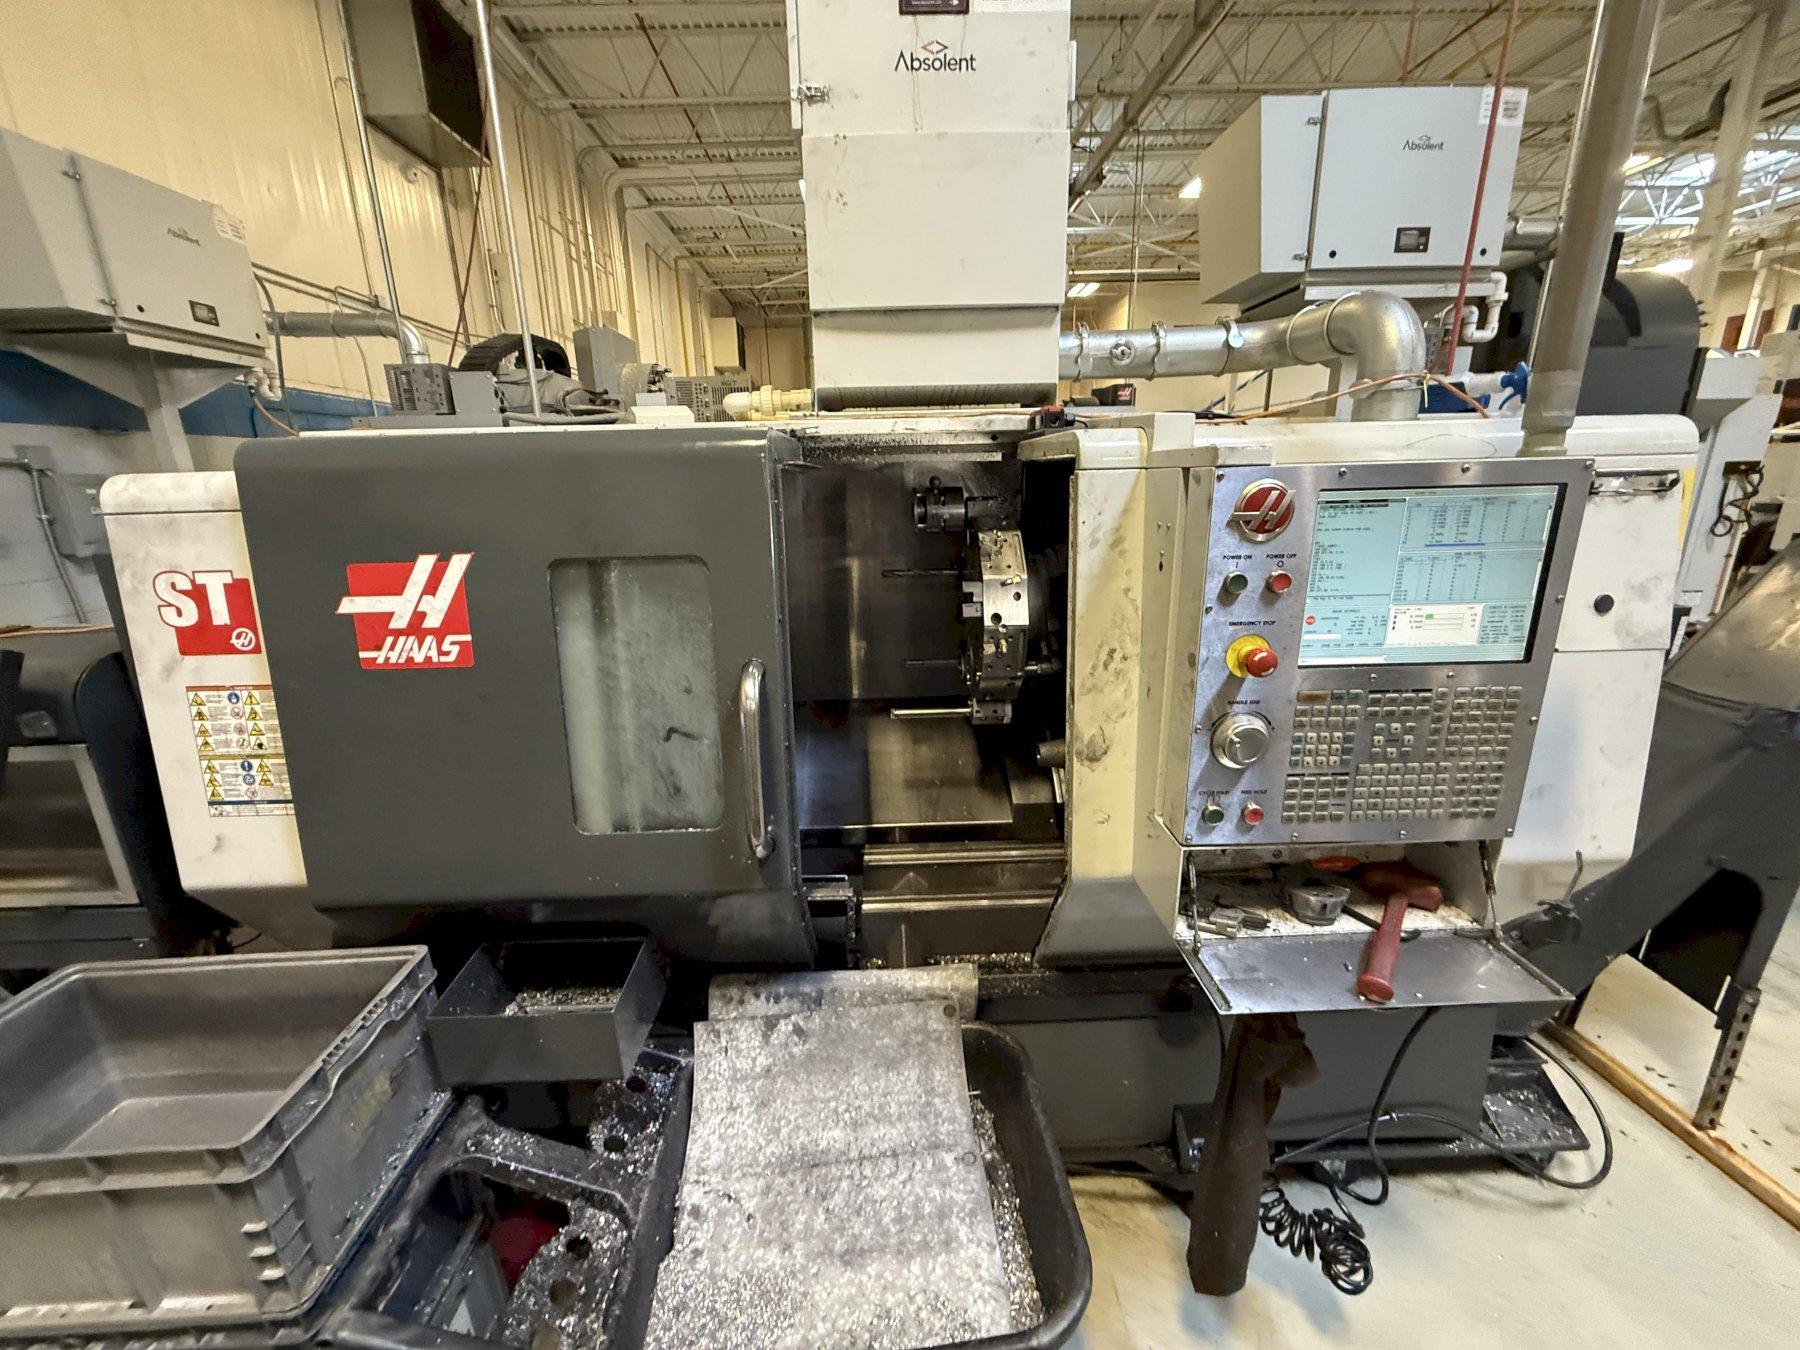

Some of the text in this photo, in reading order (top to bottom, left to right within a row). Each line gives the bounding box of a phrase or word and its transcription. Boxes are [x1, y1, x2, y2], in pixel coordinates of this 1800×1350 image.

[894, 49, 976, 72] Absolent
[1402, 140, 1444, 151] Absolent
[153, 570, 234, 628] ST
[359, 633, 472, 665] HAAS
